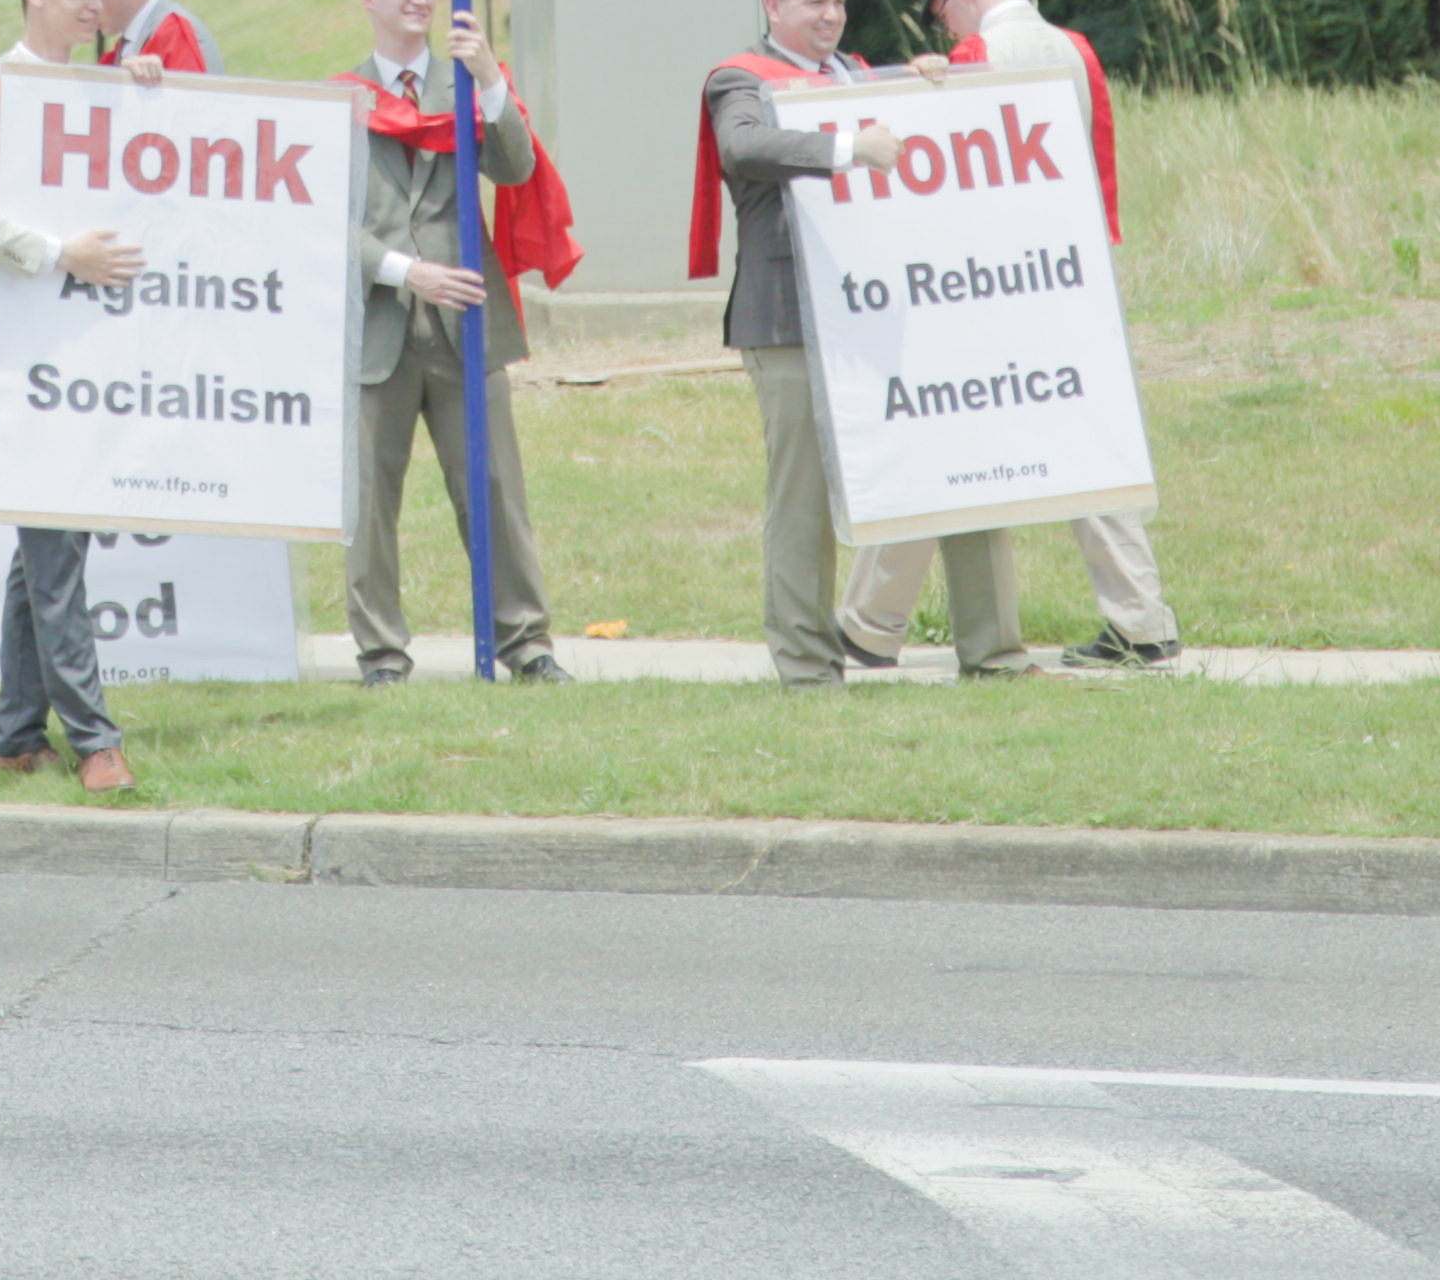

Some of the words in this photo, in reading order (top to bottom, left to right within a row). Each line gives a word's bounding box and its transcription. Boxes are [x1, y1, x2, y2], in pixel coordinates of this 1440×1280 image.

[39, 101, 314, 206] Honk
[841, 270, 890, 314] to
[905, 243, 1085, 308] Rebuild
[26, 362, 313, 427] Socialism
[883, 361, 1085, 422] America
[111, 474, 229, 498] www.tfp.org
[946, 460, 1049, 487] www.tfp.org
[87, 580, 179, 642] od
